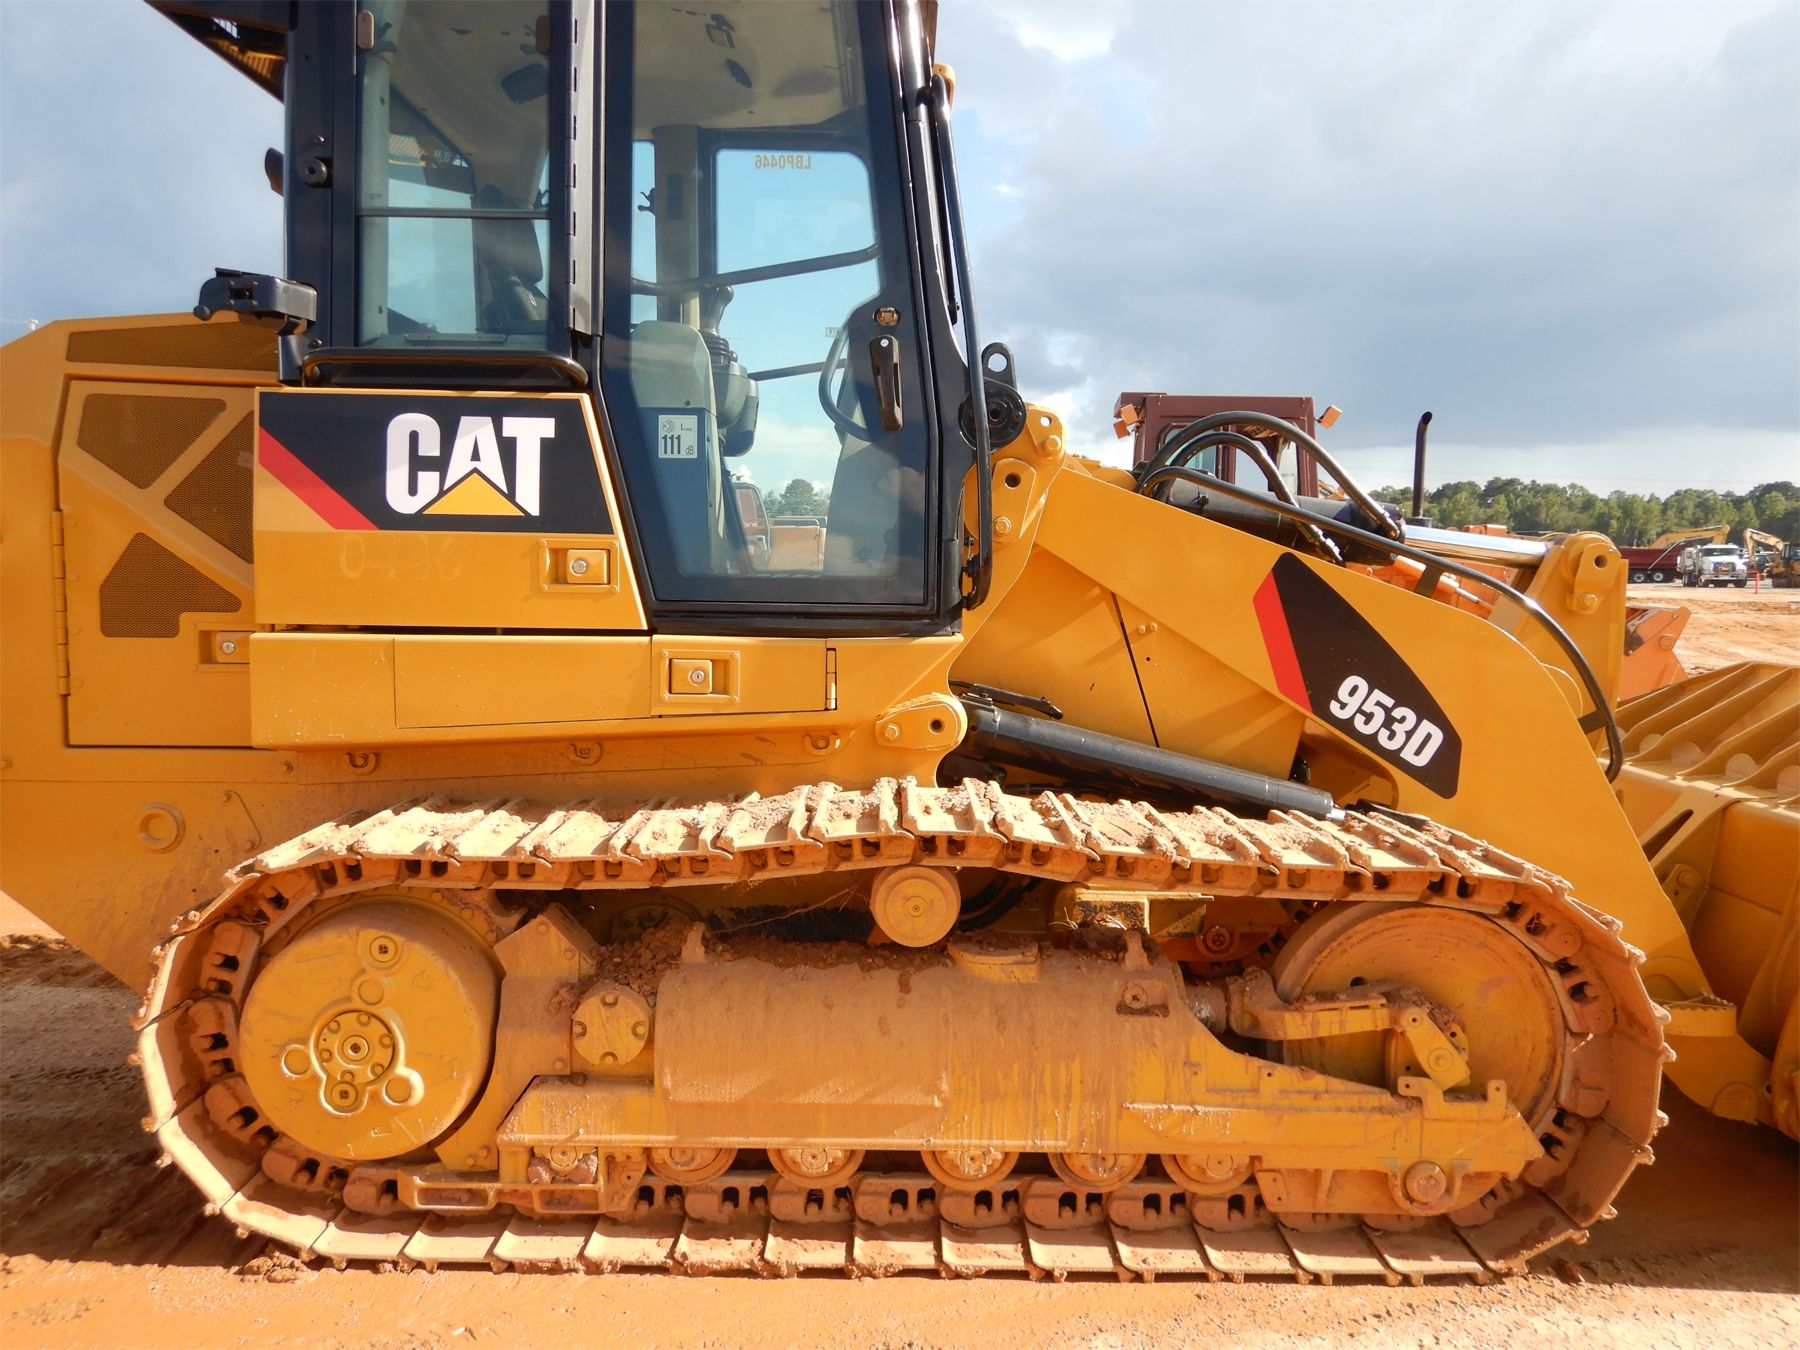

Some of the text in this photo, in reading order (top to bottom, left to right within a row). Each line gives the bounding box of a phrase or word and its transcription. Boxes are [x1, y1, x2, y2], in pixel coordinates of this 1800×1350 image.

[386, 413, 555, 516] CAT
[662, 434, 681, 455] 111
[1329, 675, 1444, 767] 953D
